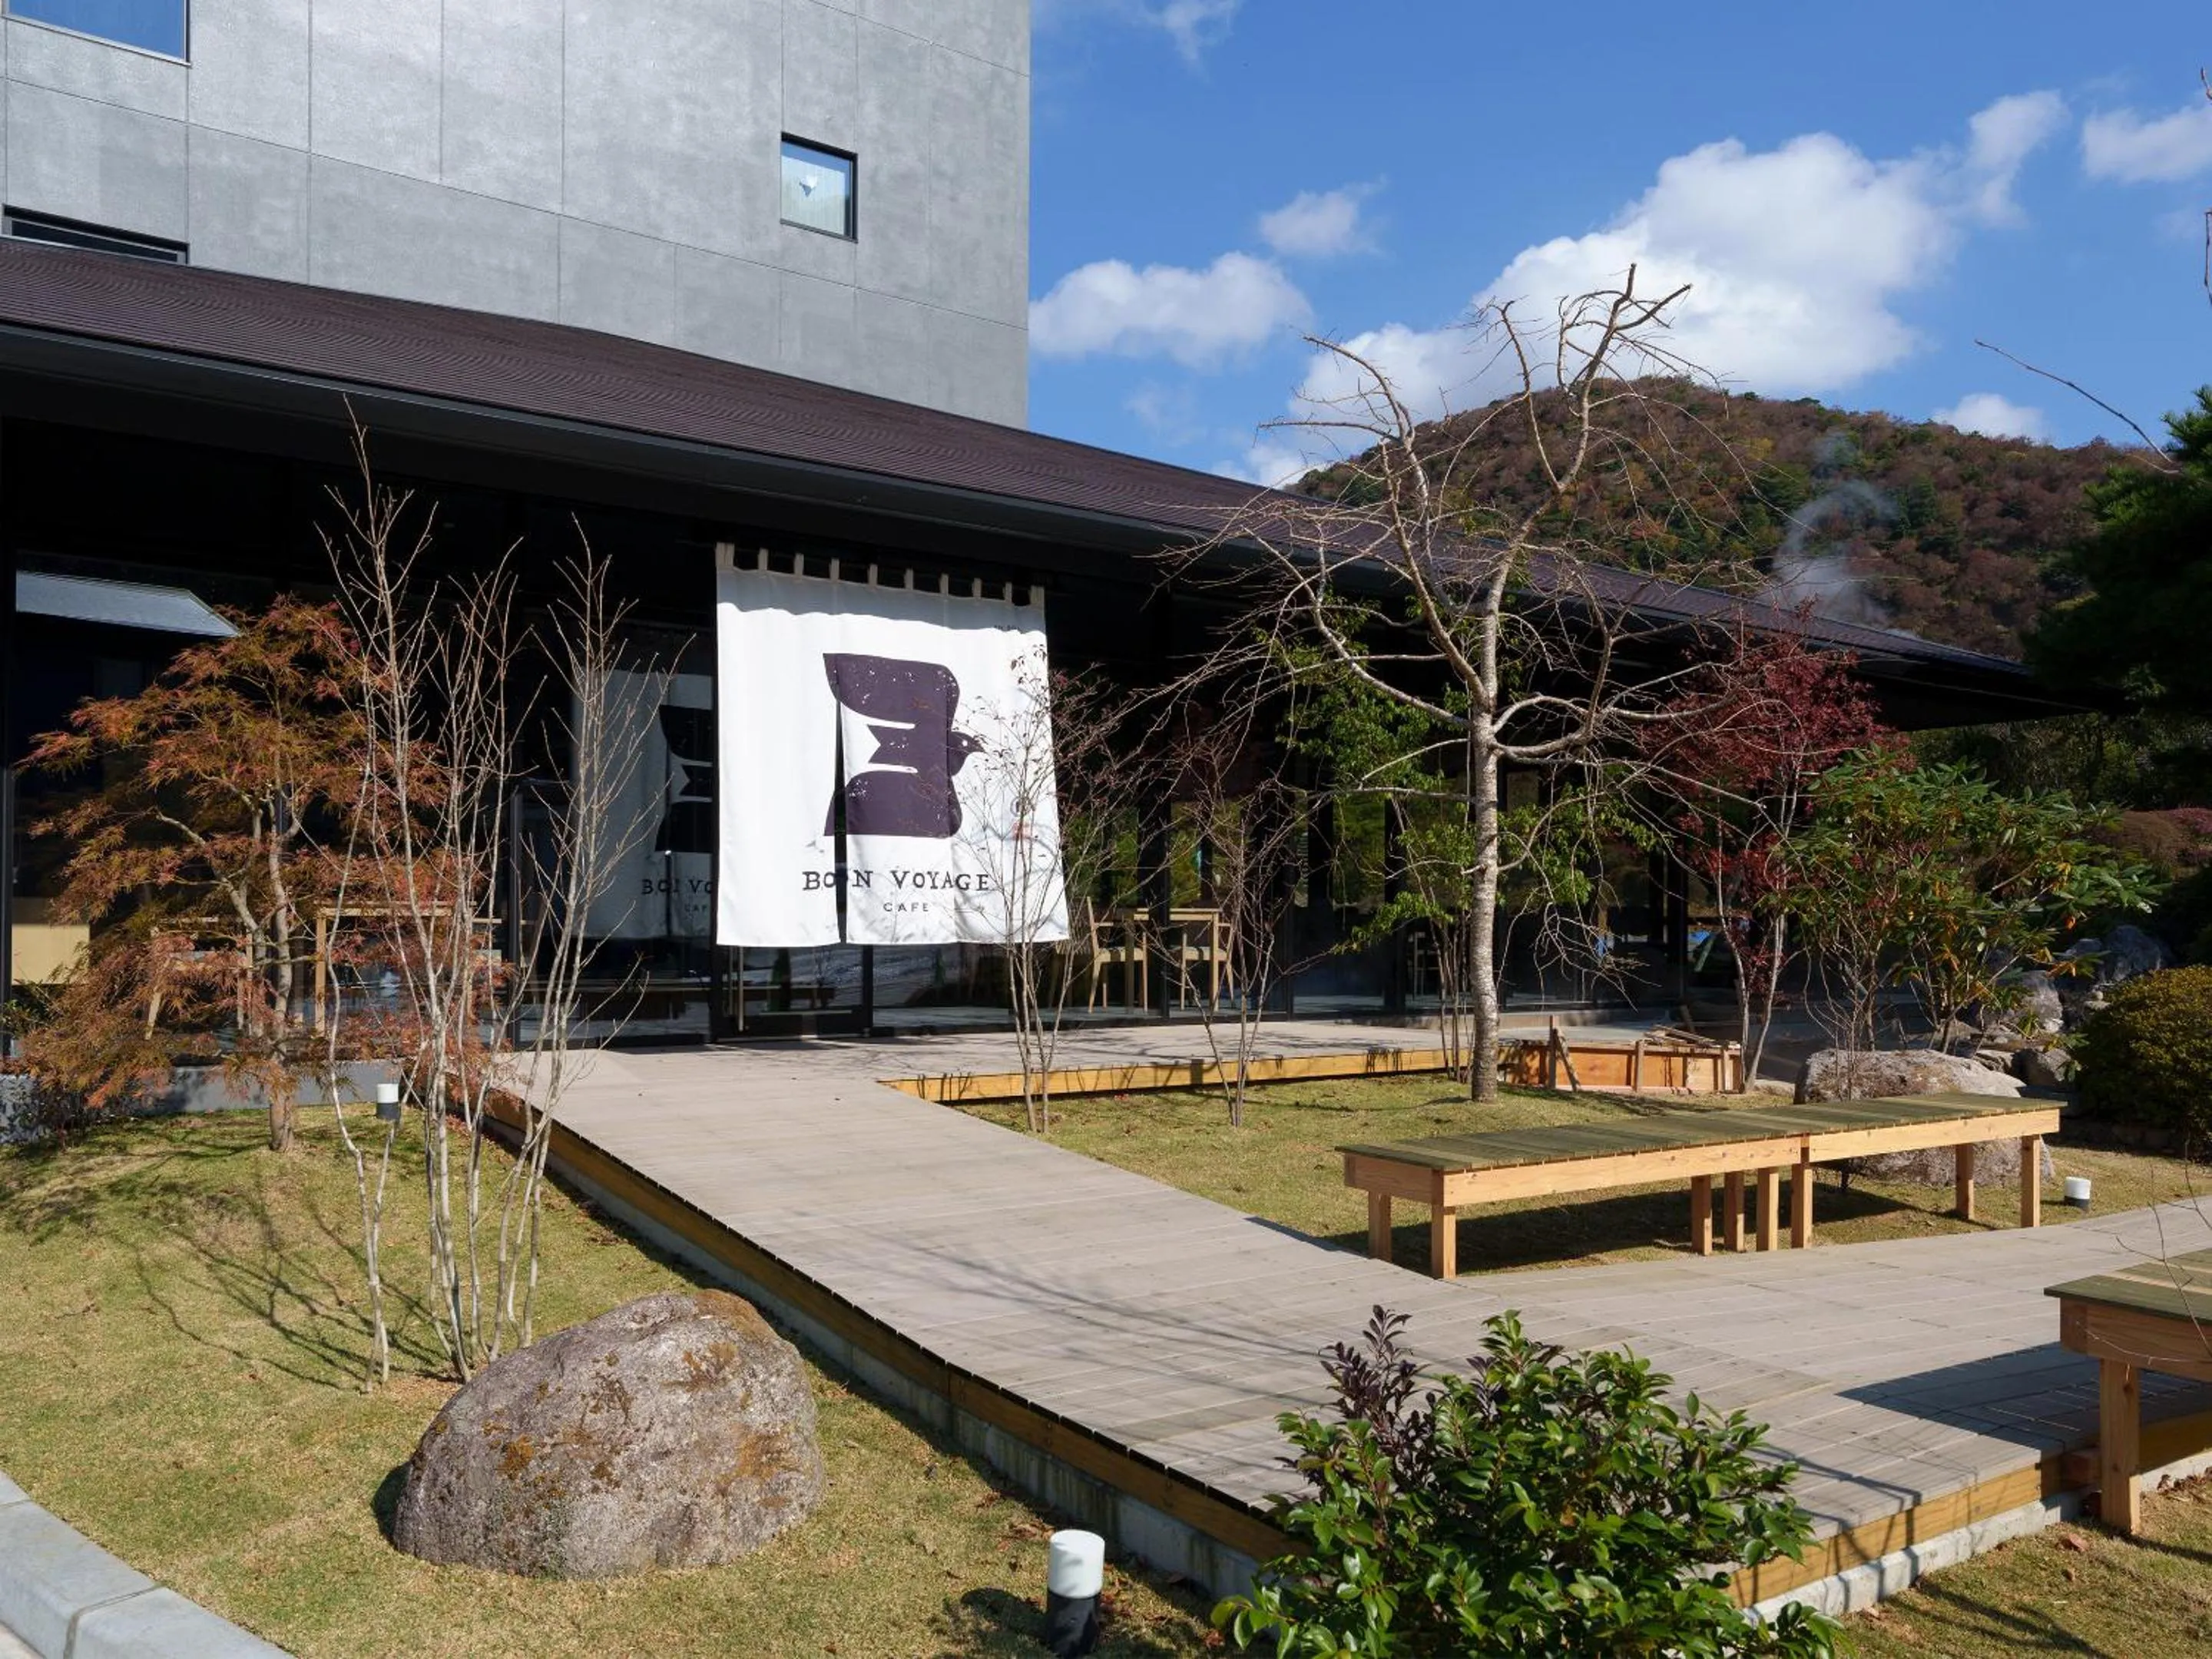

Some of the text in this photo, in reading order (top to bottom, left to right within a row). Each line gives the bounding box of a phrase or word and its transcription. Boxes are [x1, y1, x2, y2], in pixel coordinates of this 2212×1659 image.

[802, 869, 989, 891] BON VOYAGE
[883, 902, 929, 912] CAFE
